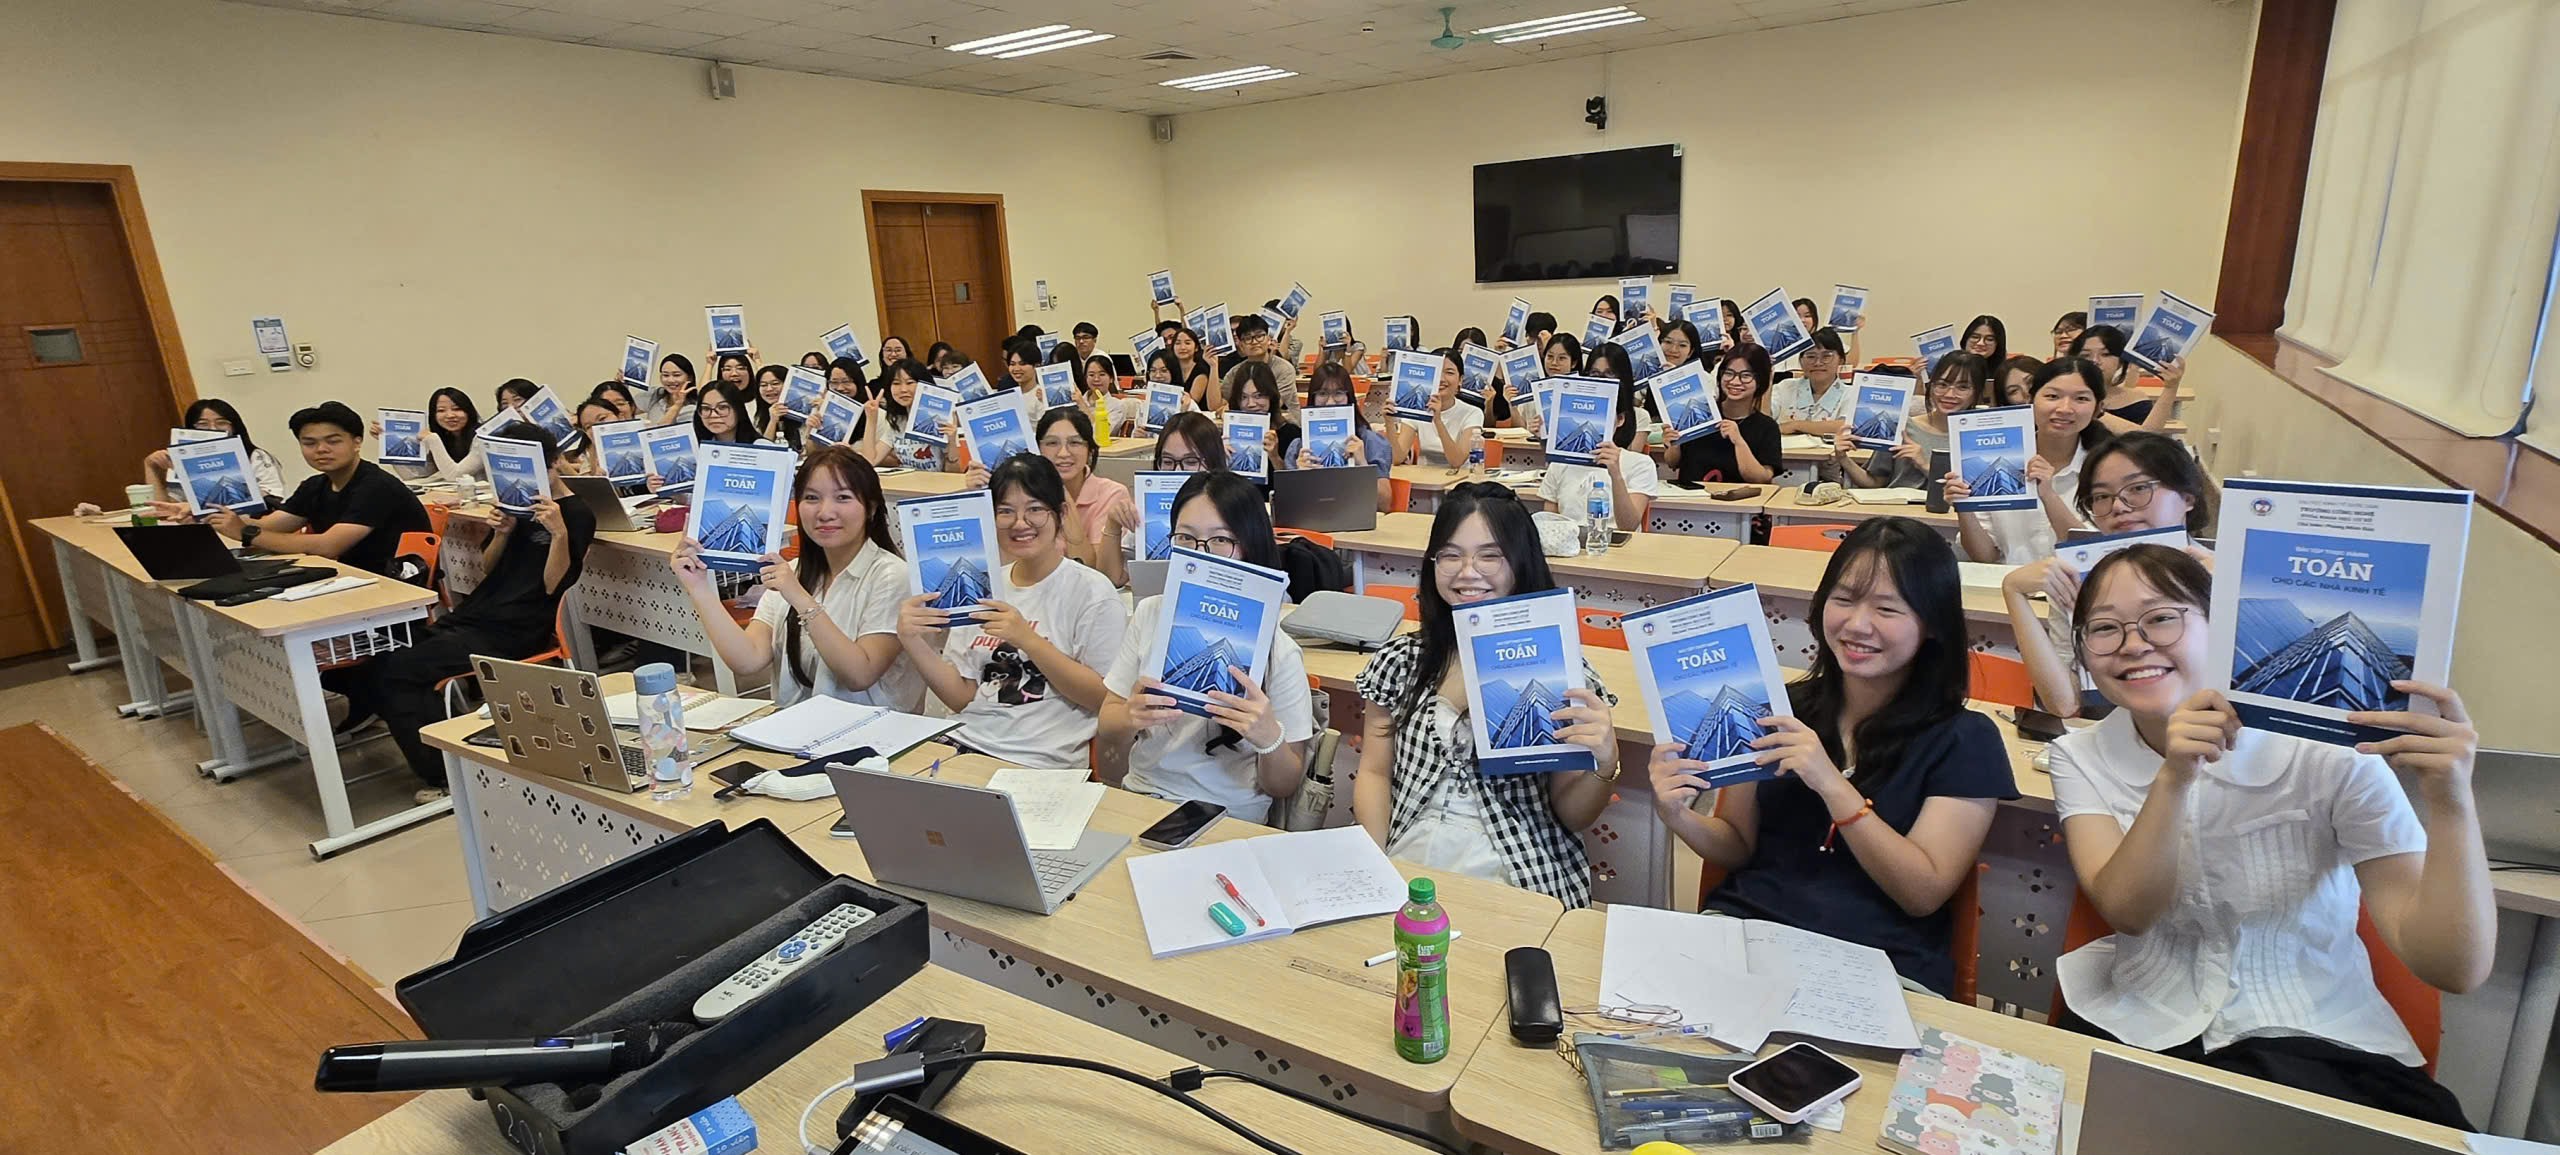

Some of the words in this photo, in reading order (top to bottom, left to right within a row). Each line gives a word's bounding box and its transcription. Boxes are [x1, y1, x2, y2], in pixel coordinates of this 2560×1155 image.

[1572, 402, 1595, 411] TOÁN
[984, 421, 1007, 433] TOÁN
[1976, 435, 2006, 446] TOÁN
[724, 477, 756, 489] TOÁN
[1159, 502, 1171, 510] TO
[933, 531, 964, 543] TOÁN
[2288, 556, 2374, 582] TOÁN
[2271, 576, 2293, 585] CHO
[2295, 577, 2317, 588] CÁC
[1200, 601, 1239, 620] TOÁN
[1495, 643, 1537, 661] TOÁN
[1677, 648, 1727, 670] TOÁN
